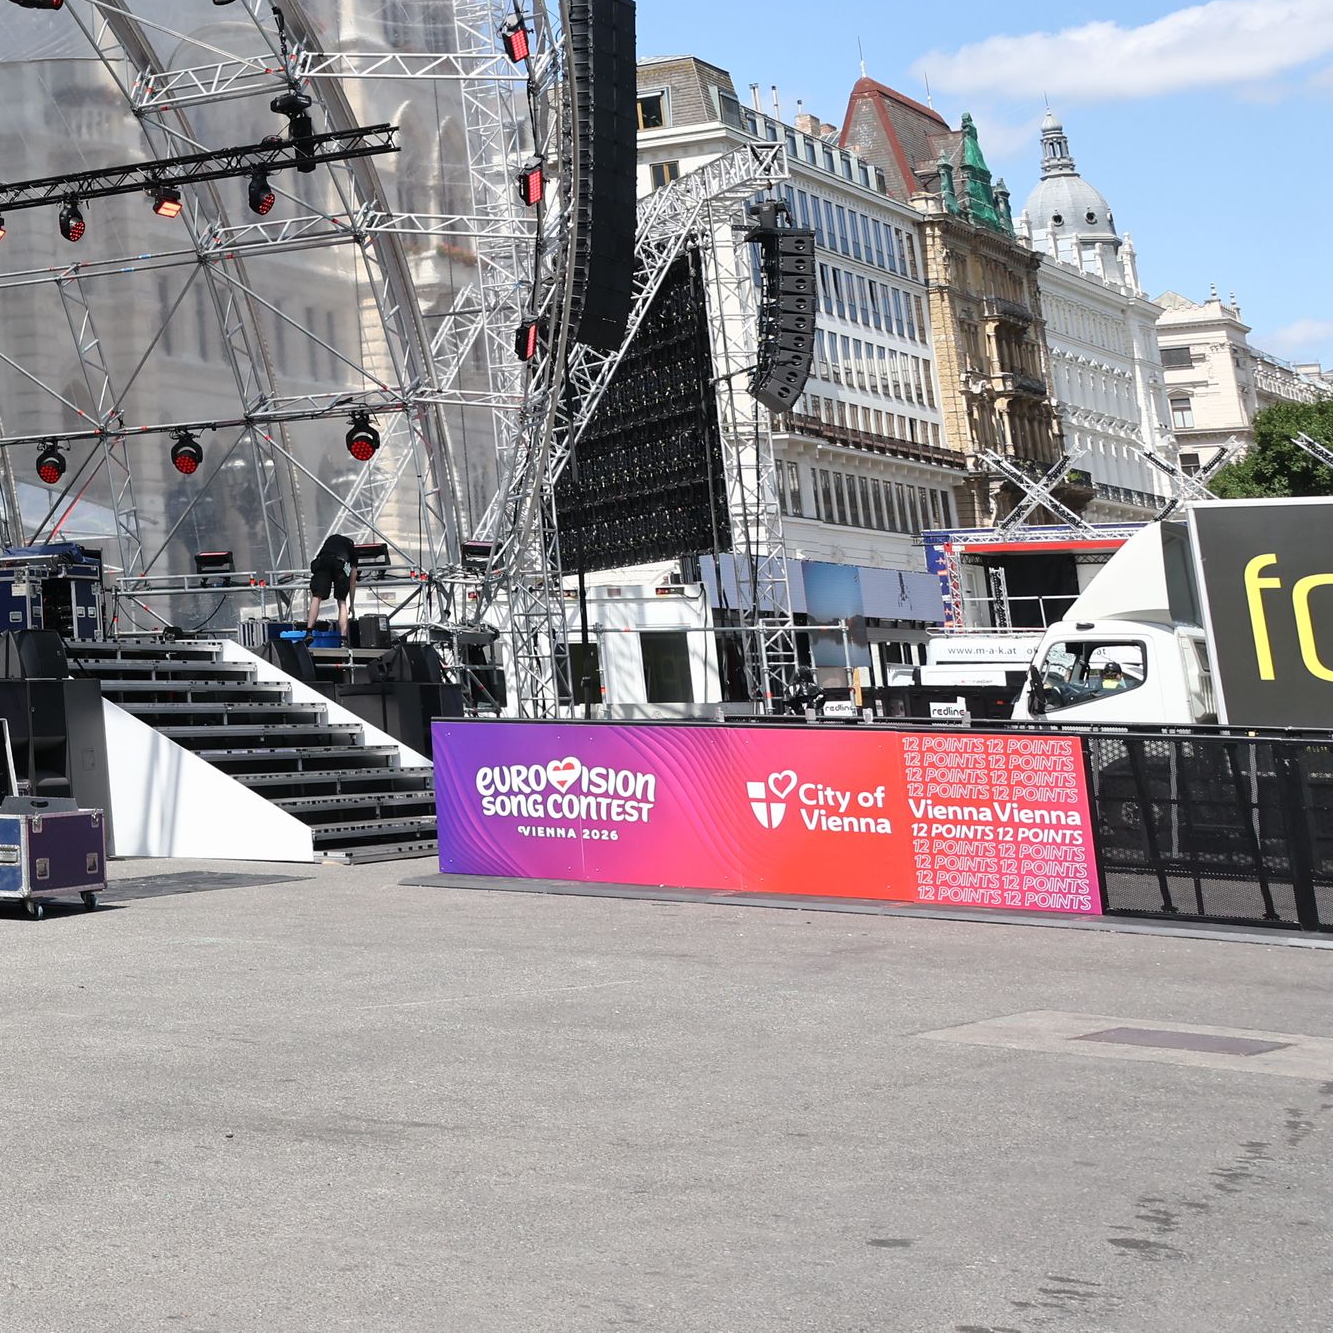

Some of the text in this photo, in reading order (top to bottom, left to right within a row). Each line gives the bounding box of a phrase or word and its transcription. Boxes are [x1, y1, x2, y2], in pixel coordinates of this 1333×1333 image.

[947, 647, 1017, 656] www.m-a-k.at
[902, 737, 1072, 755] 12 POINTS 12 POINTS
[904, 752, 1074, 771] 12 POINTS 12 POINTS
[906, 768, 1076, 787] 12 POINTS 12 POINTS
[798, 783, 886, 813] City of
[907, 783, 1077, 803] 12 POINTS 12 POINTS
[800, 808, 892, 834] Vienna
[908, 799, 1081, 825] Vienna Vienna
[517, 826, 619, 841] VIENNA 2026
[911, 824, 1083, 844] 12 POINTS 12 POINTS
[913, 839, 1085, 861] 12 POINTS 12 POINTS
[914, 855, 1087, 878] 12 POINTS 12 POINTS
[916, 871, 1089, 894] 12 POINTS 12 POINTS
[918, 886, 1091, 910] 12 POINTS 12 POINTS
